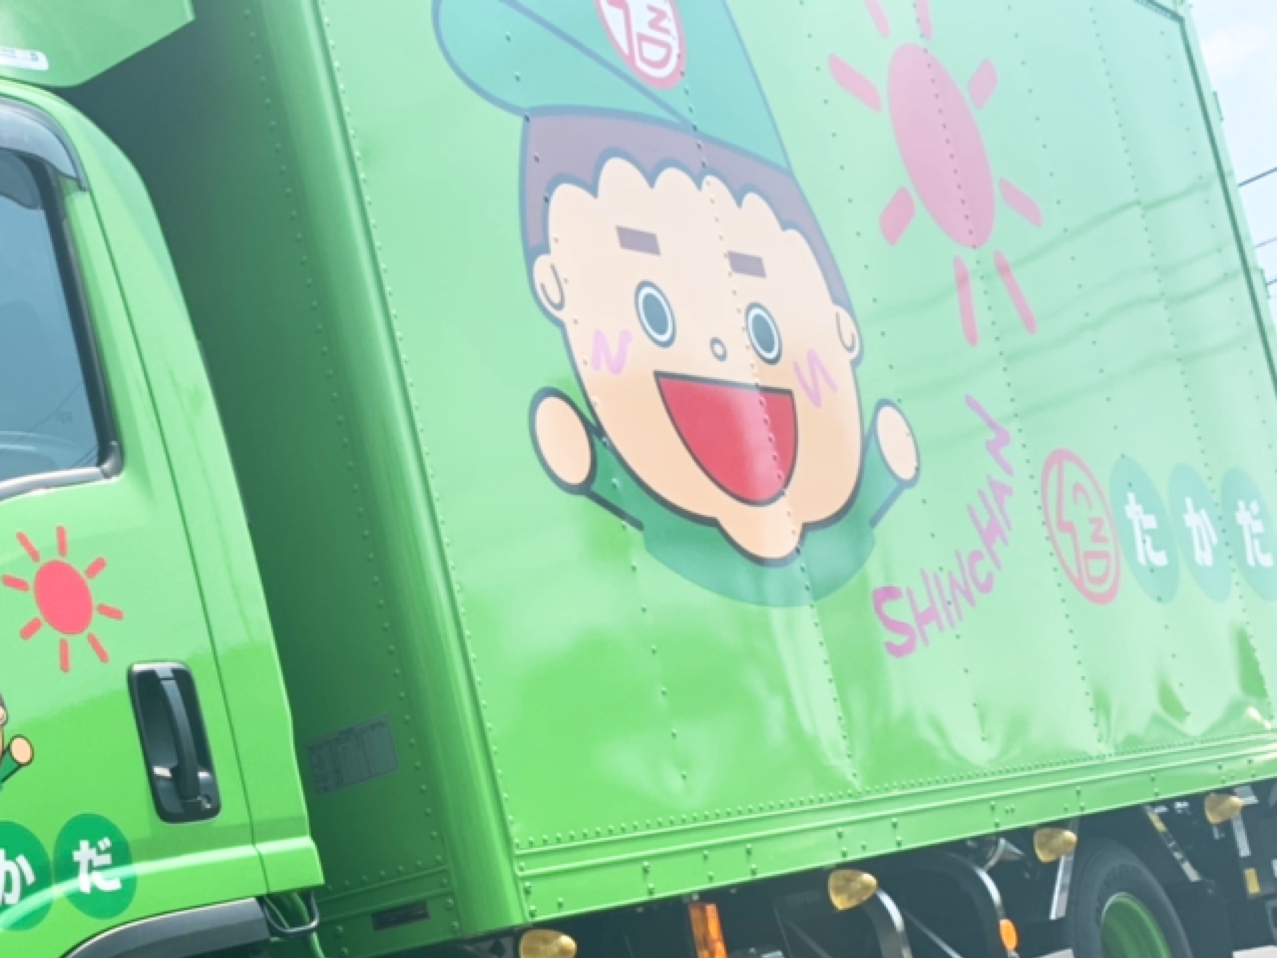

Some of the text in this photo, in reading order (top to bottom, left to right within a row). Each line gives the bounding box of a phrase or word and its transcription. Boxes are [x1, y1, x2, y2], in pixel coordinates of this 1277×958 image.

[871, 394, 1015, 658] SHINCHAN
[1124, 491, 1274, 568] たかだ
